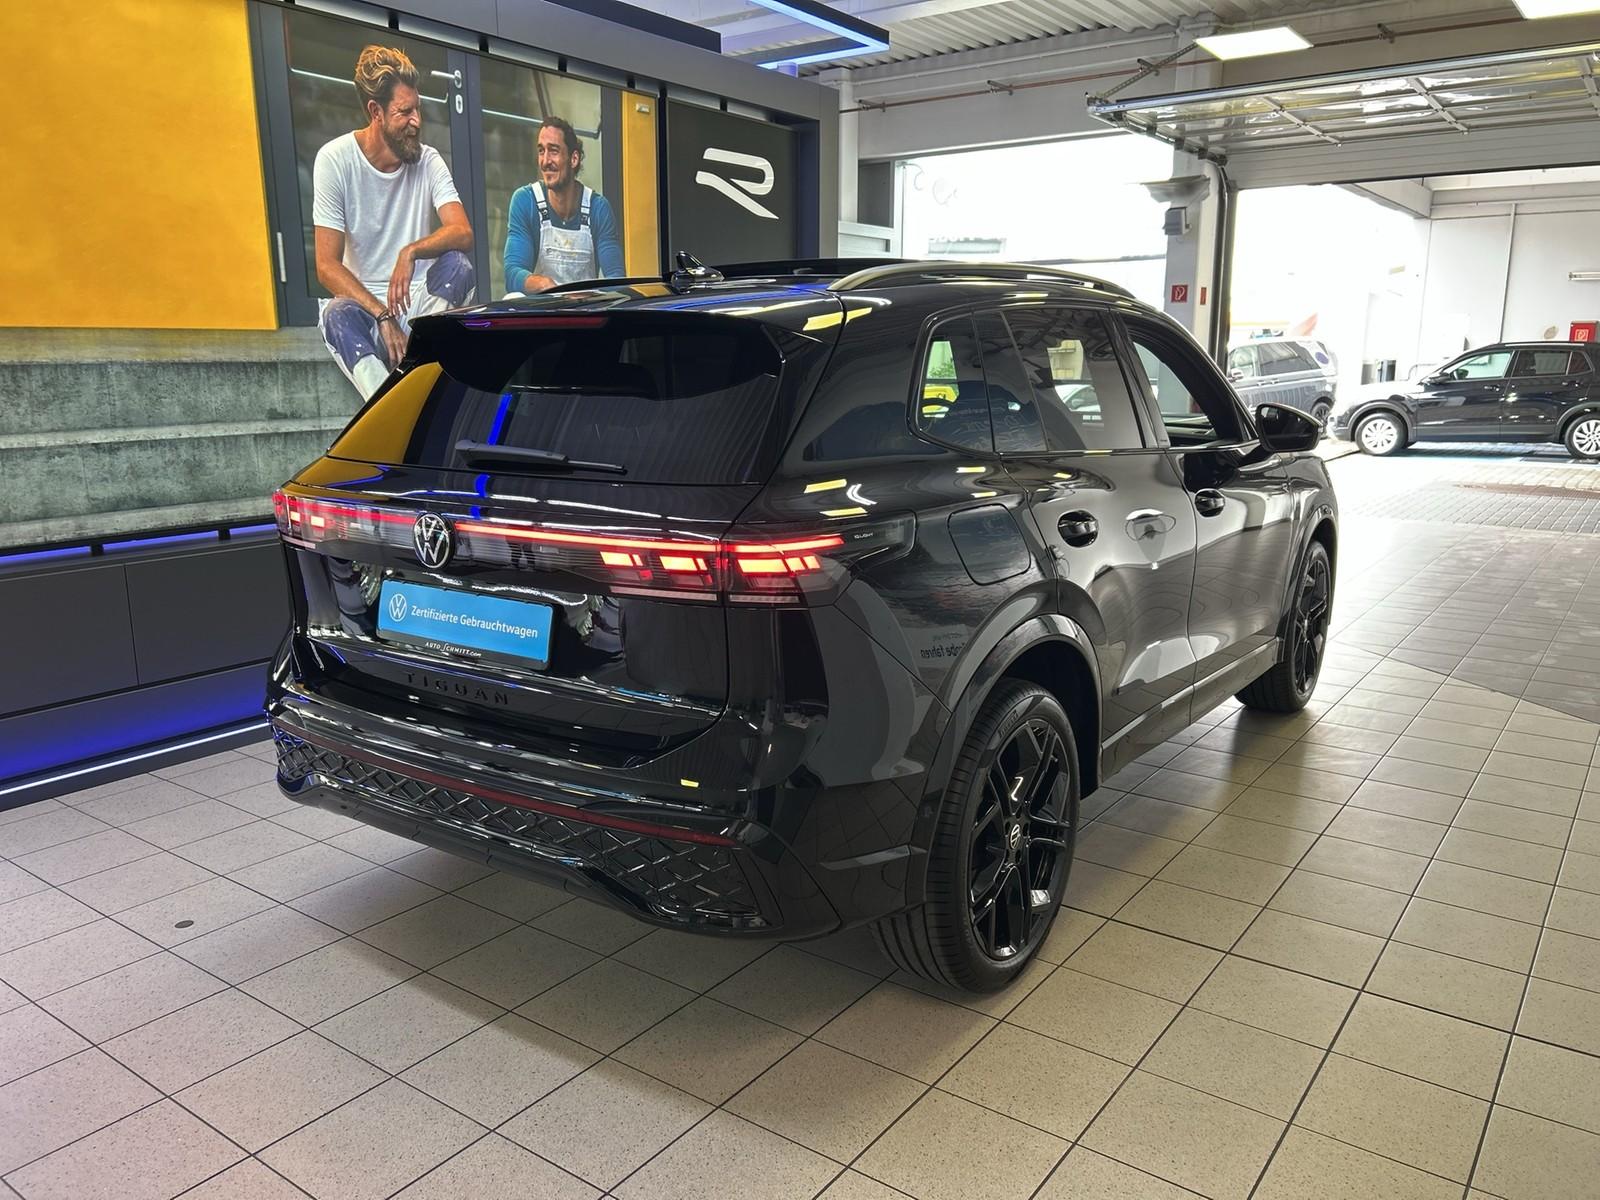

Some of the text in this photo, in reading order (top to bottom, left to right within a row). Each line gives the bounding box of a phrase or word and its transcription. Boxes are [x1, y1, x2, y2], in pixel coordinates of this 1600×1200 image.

[411, 605, 538, 639] Zertifizierte Gebrauchtwagen
[425, 641, 441, 650] AUTO
[407, 673, 508, 705] TIGUAN
